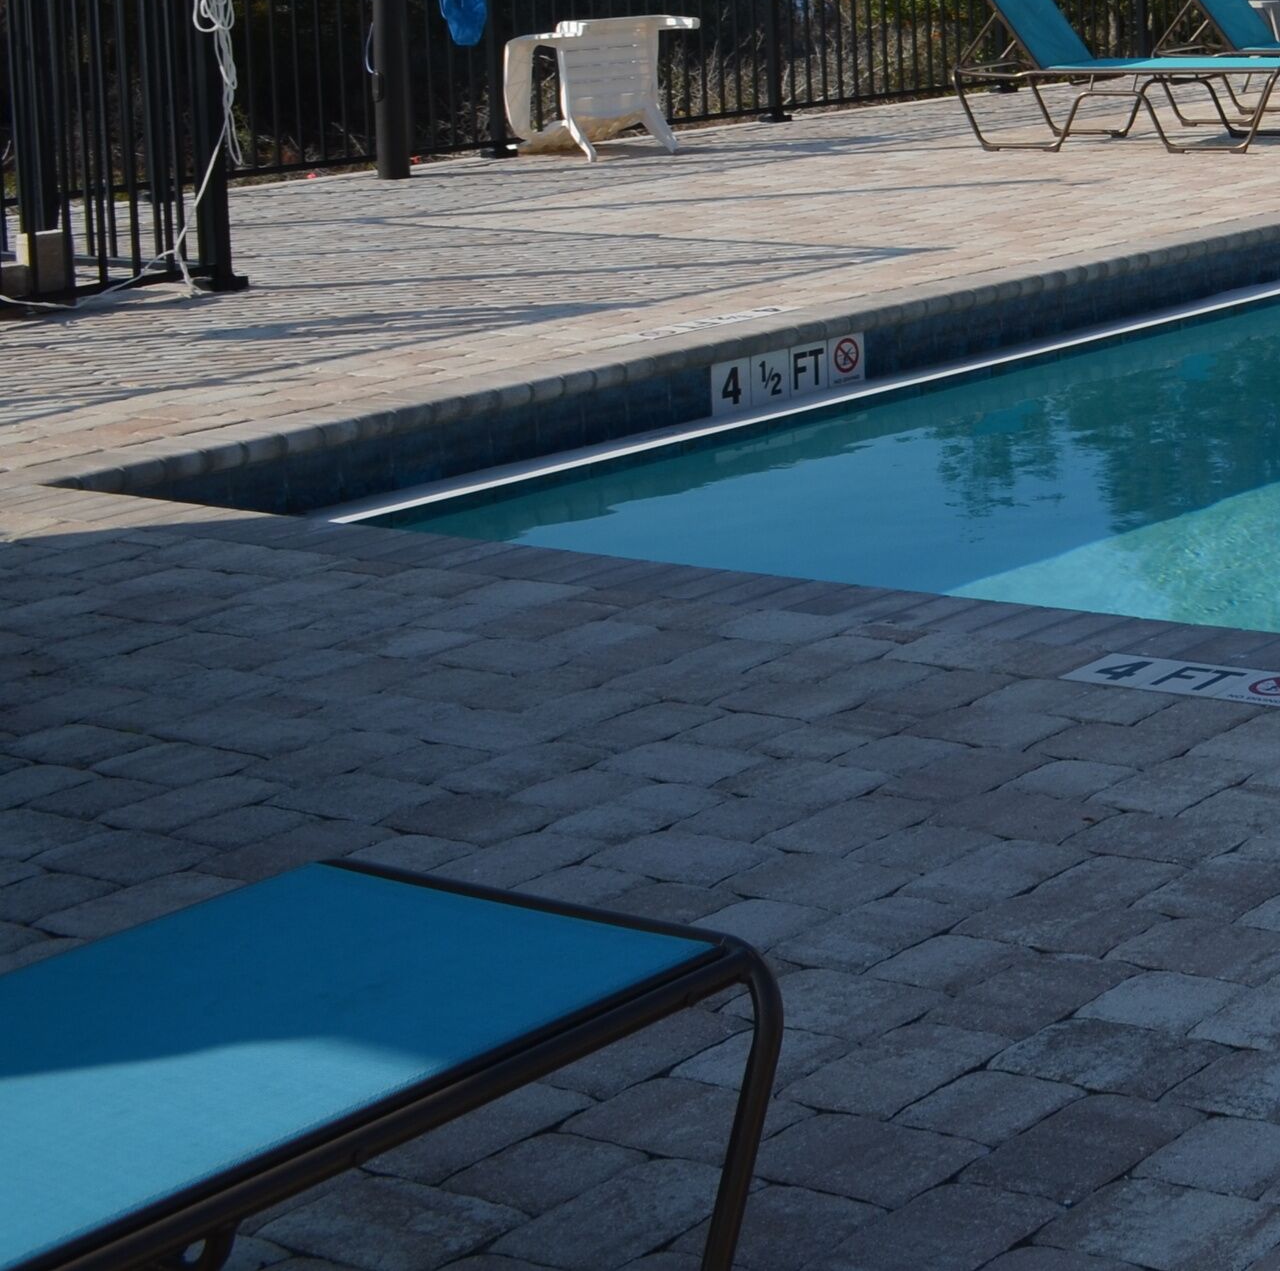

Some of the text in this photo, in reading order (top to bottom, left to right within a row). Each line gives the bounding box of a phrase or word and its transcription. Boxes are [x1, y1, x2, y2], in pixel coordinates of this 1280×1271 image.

[721, 366, 742, 405] 4
[793, 347, 824, 390] FT
[1095, 660, 1248, 691] 4 FT
